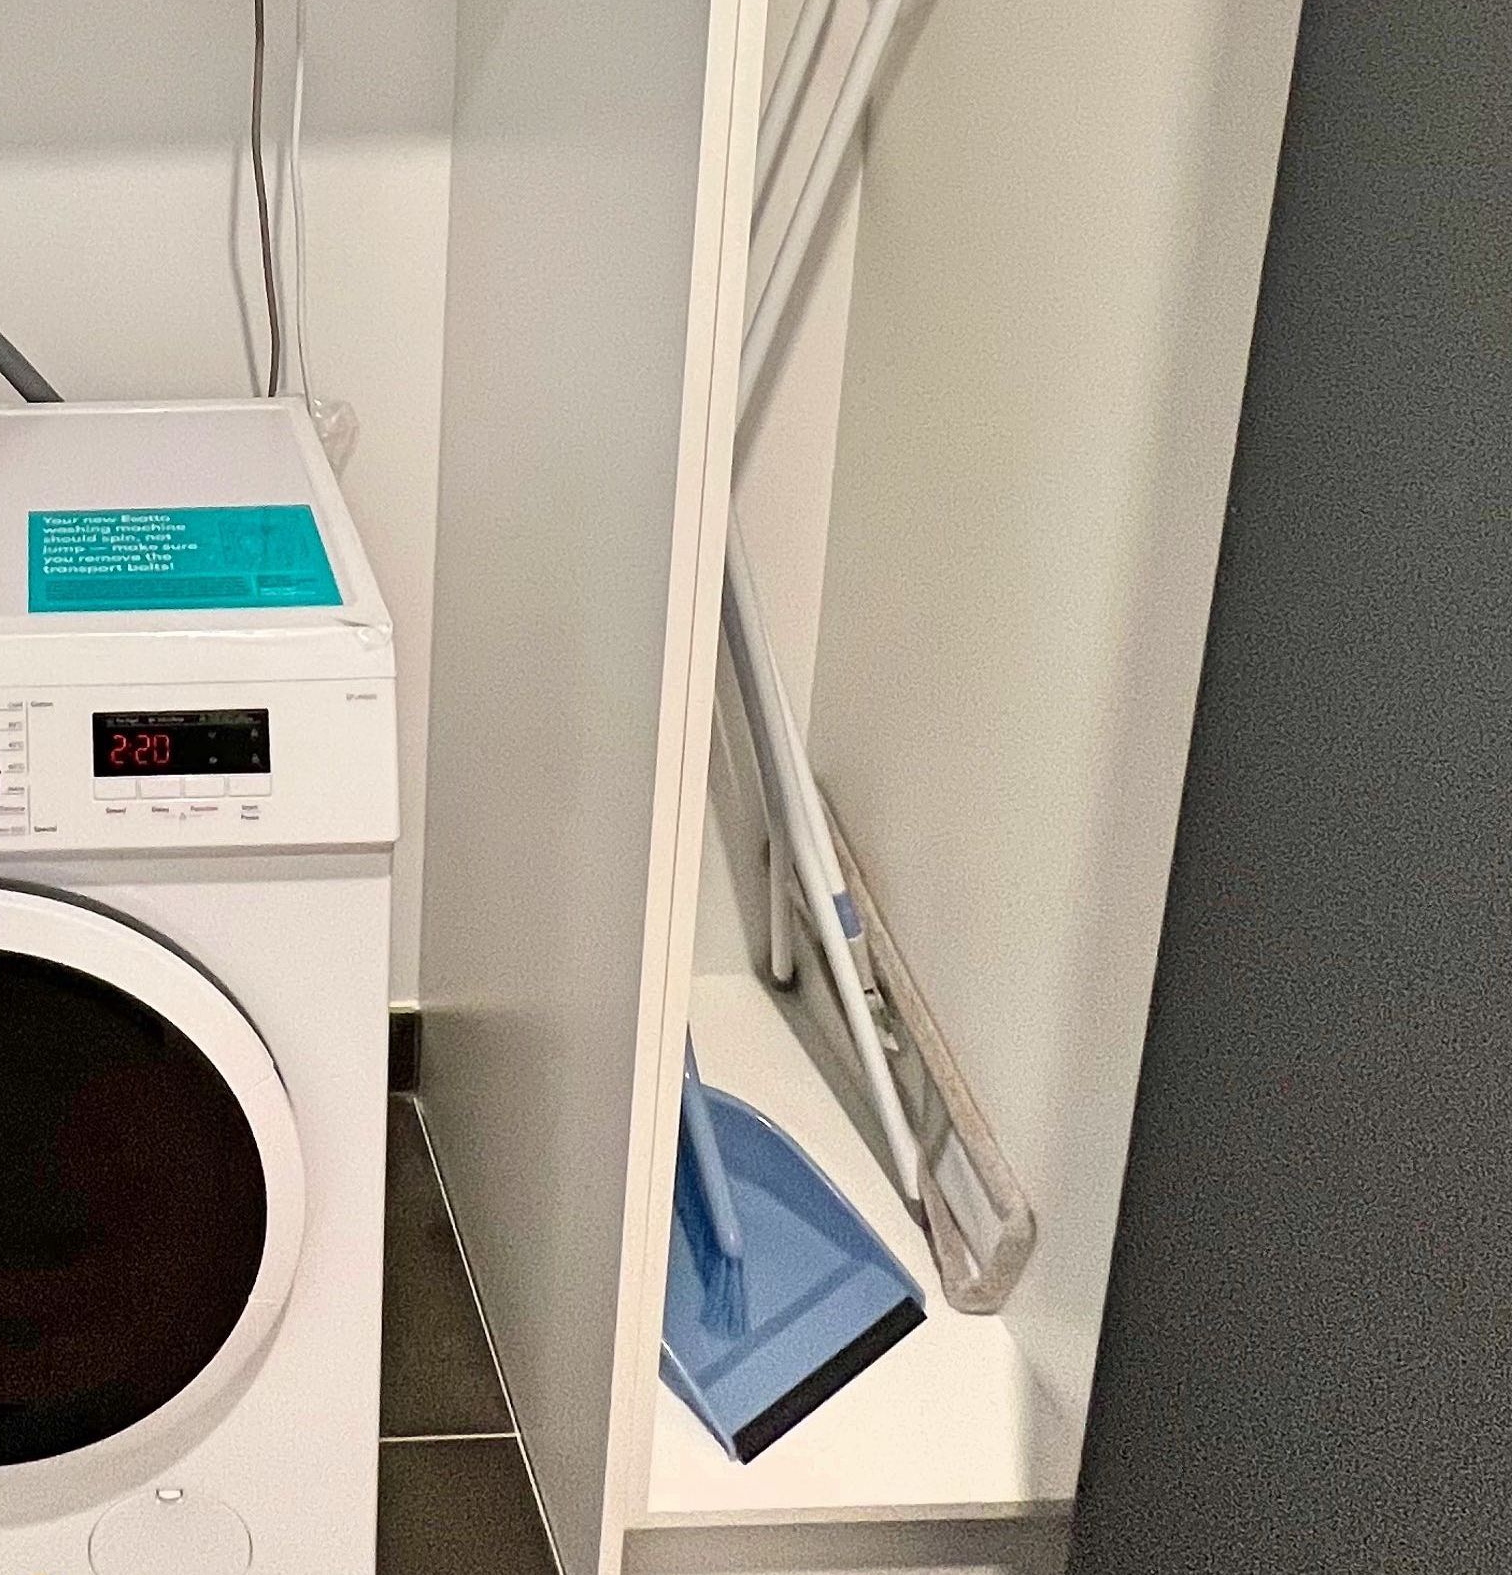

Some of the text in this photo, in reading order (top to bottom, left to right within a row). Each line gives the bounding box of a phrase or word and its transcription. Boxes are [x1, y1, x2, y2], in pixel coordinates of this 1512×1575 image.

[43, 516, 78, 525] Your
[121, 514, 171, 523] Esatto
[43, 524, 186, 534] washing machine
[43, 534, 97, 543] should
[102, 534, 141, 543] spin,
[43, 545, 86, 554] jump
[112, 543, 158, 551] make
[162, 542, 198, 550] sure
[43, 552, 172, 564] you remove the
[43, 562, 174, 574] transport bolts!
[110, 734, 170, 764] 2:20
